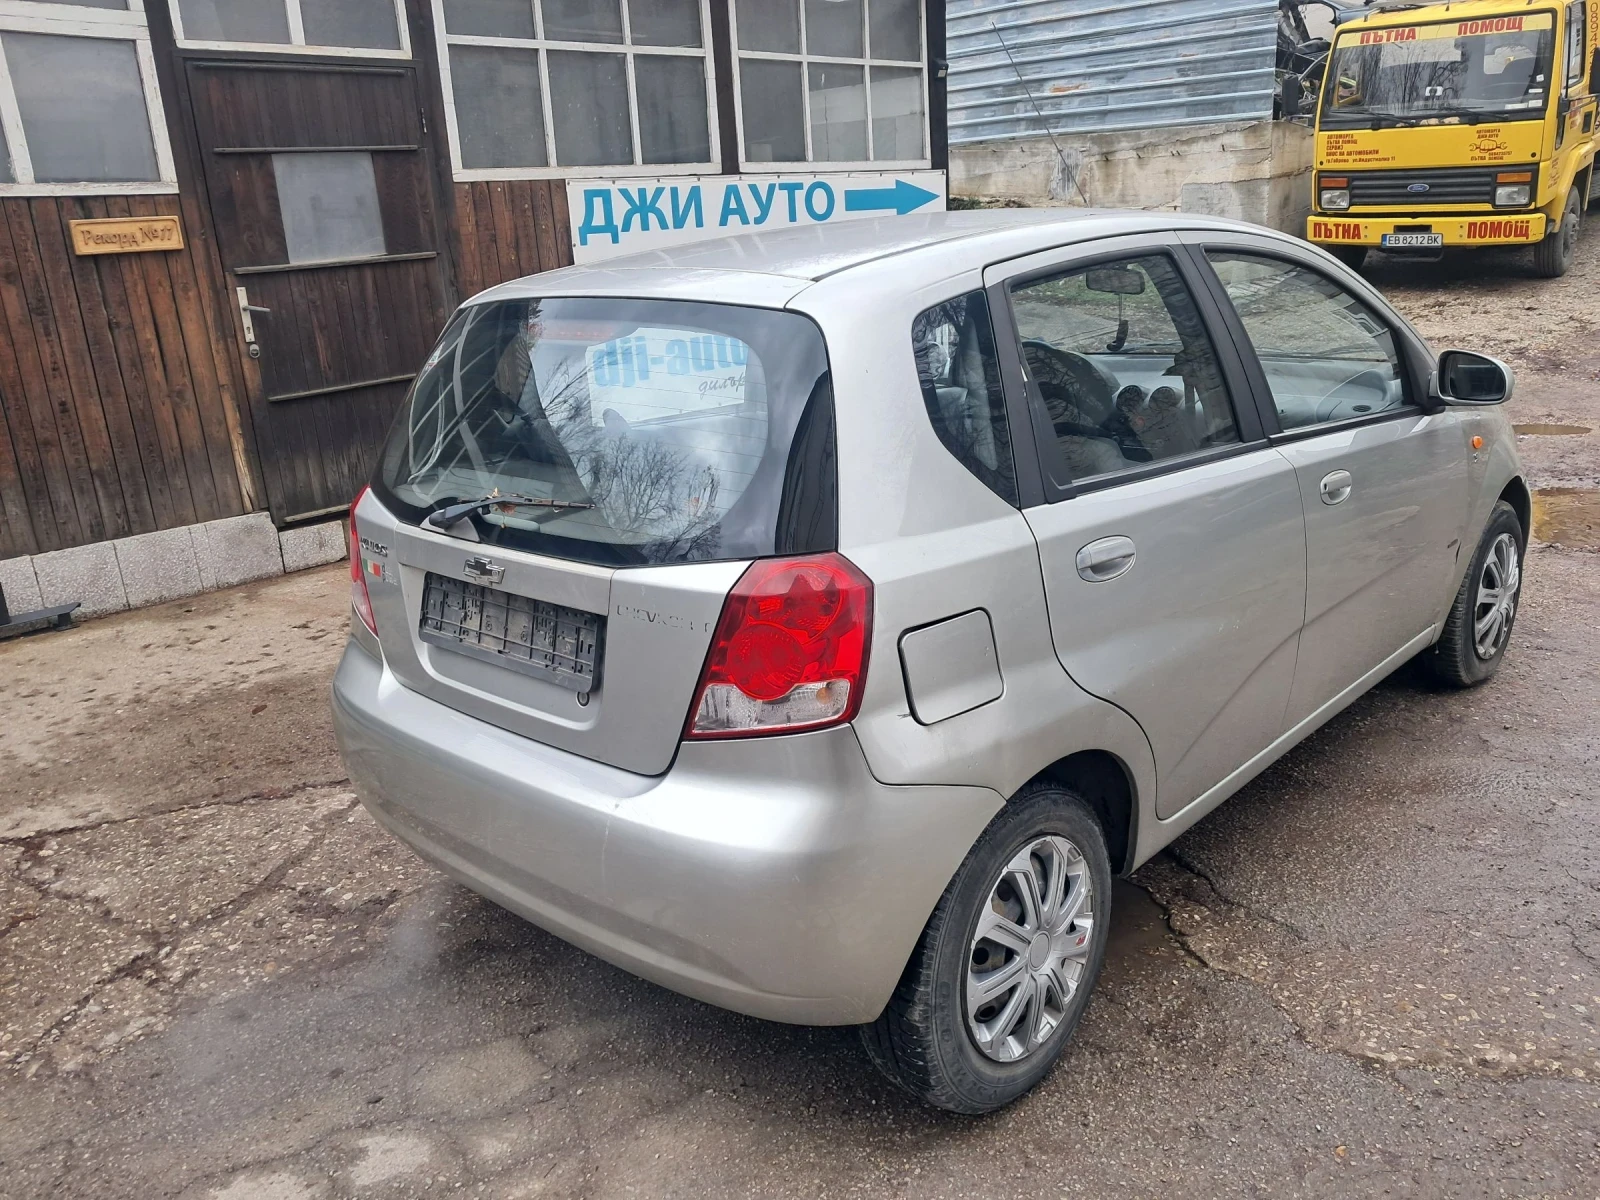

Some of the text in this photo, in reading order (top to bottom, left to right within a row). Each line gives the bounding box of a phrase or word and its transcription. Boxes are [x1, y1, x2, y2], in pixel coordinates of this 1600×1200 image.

[1360, 16, 1524, 45] ПЪТНА ПОМОЩ
[578, 181, 835, 246] ДЖИ АУТО
[1313, 220, 1531, 240] ПЪТНА ПОМОЩ
[1387, 233, 1440, 245] EB 8212 BK
[593, 335, 749, 388] dji-auto
